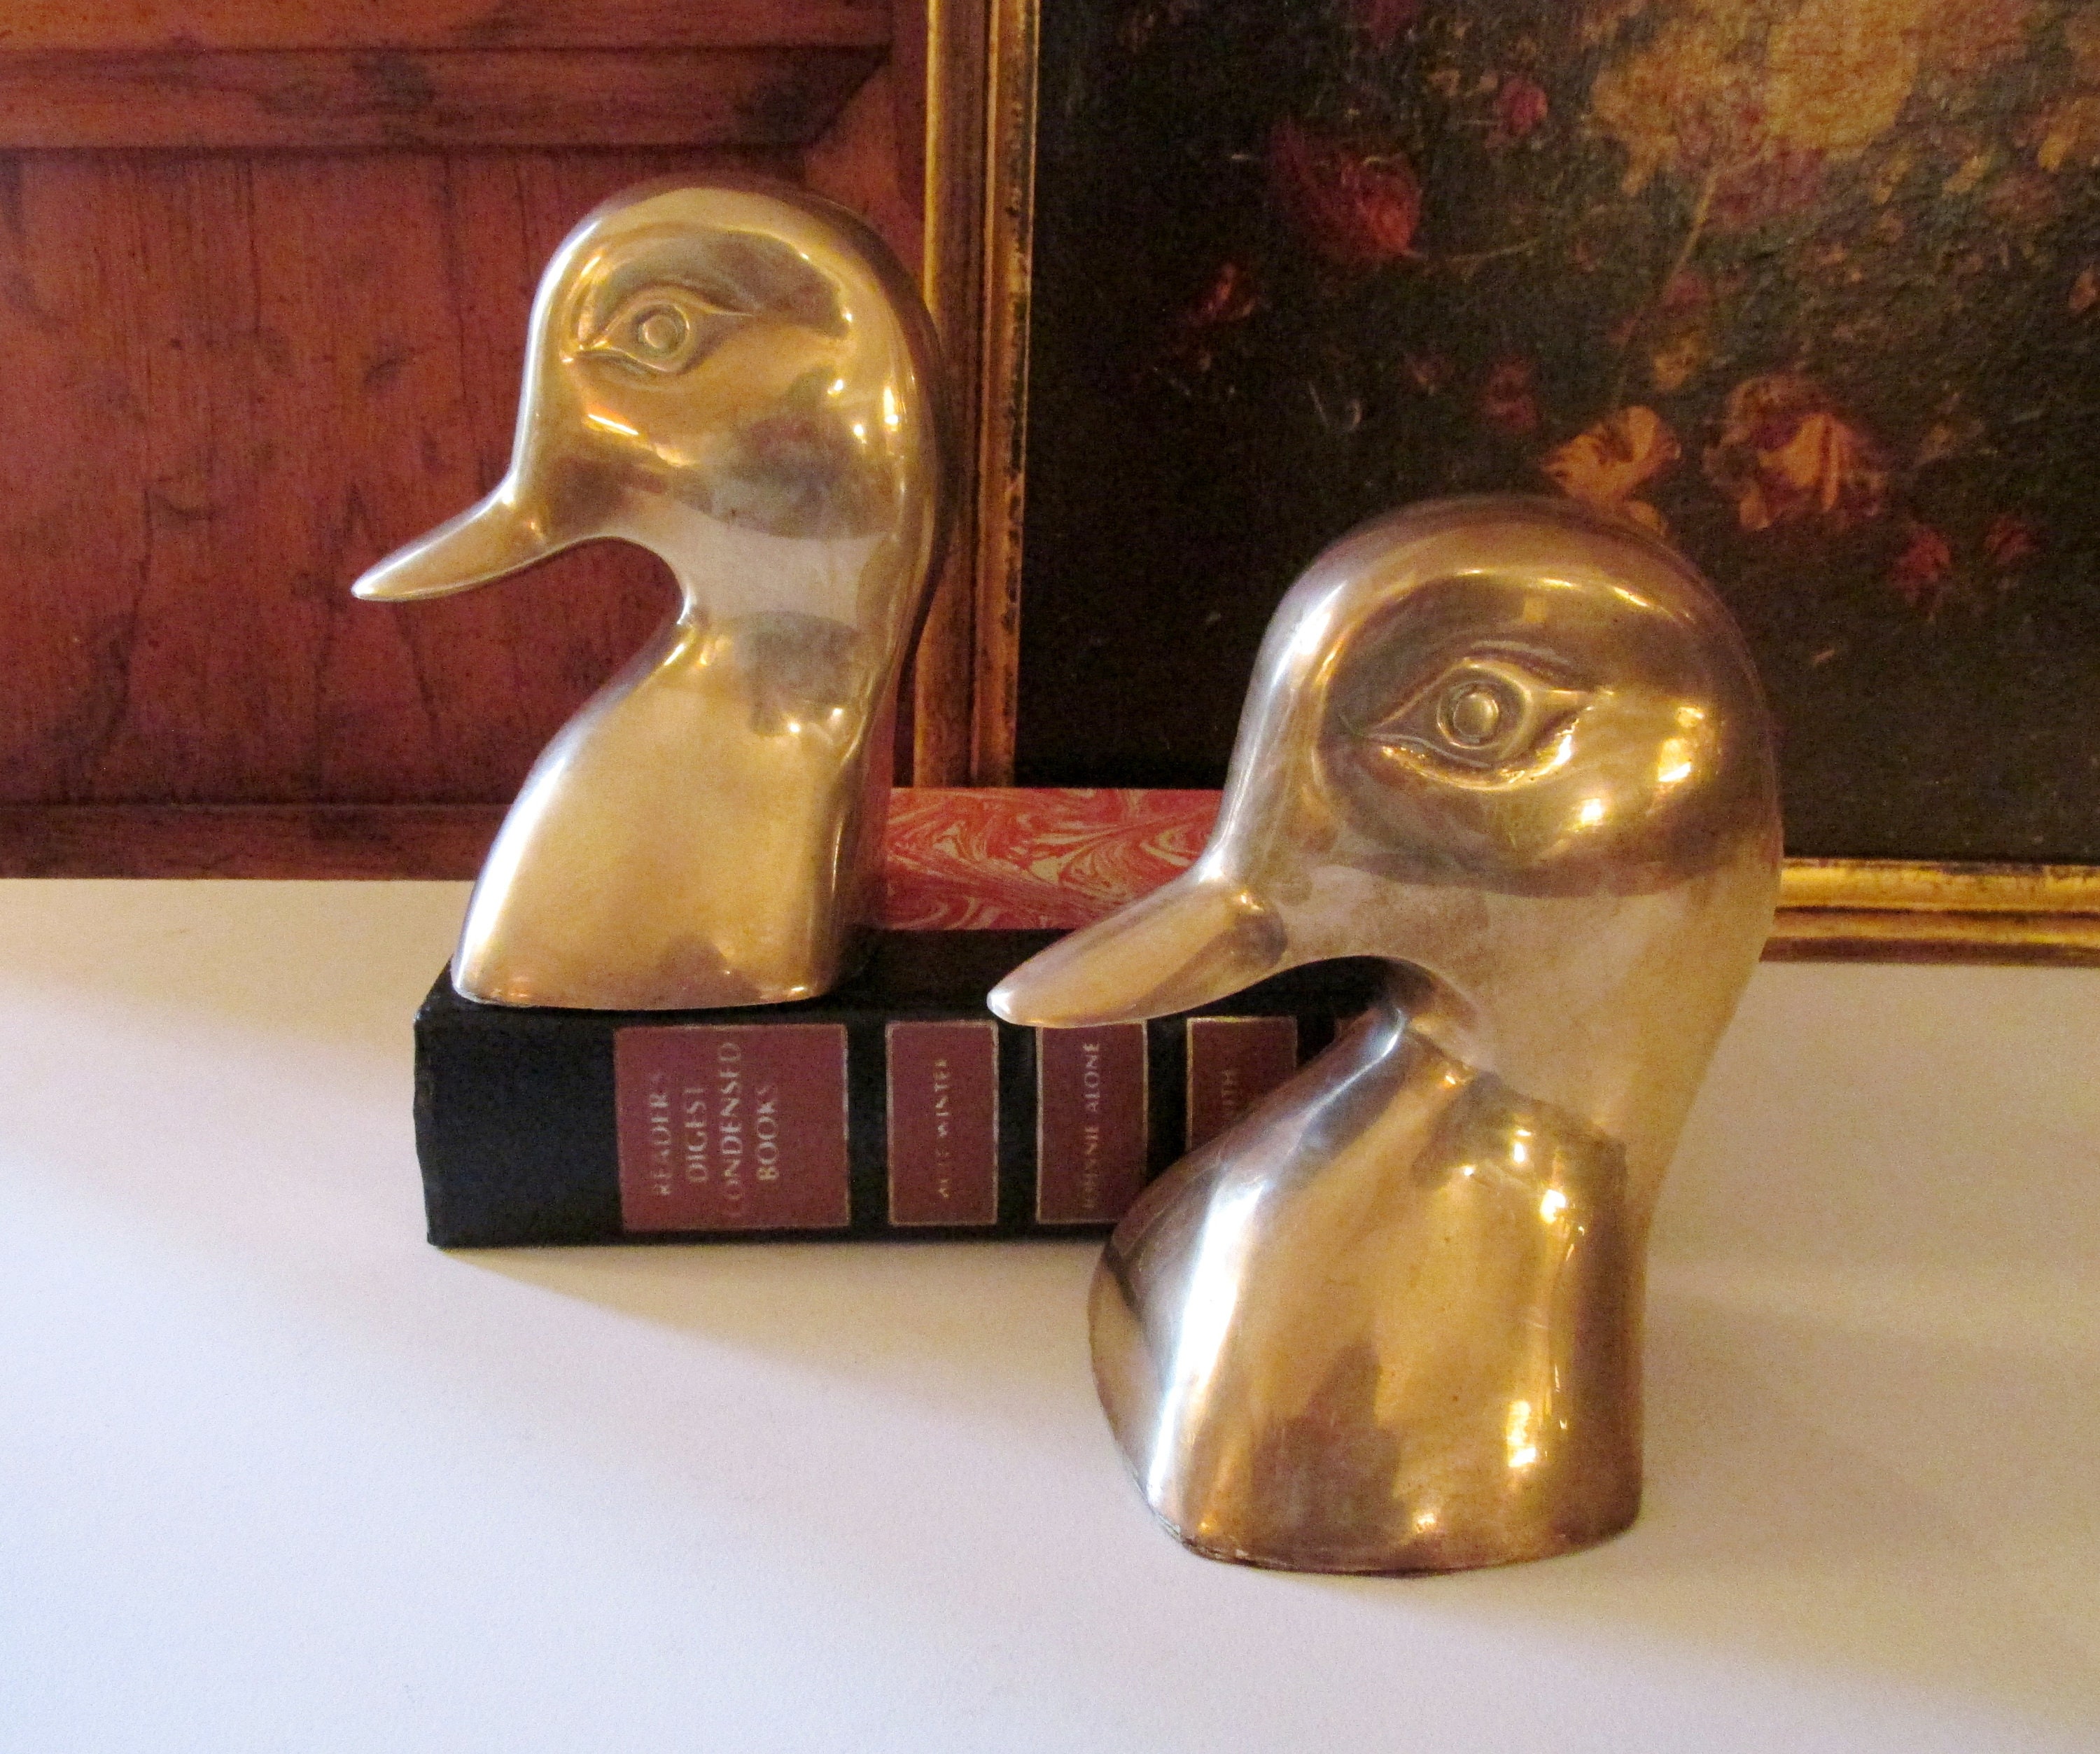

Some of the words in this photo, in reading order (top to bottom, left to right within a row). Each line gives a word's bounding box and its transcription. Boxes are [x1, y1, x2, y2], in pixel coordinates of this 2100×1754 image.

[1082, 1041, 1101, 1113] ALONE
[682, 1087, 709, 1183] DIGEST
[755, 1084, 780, 1181] BOOKS
